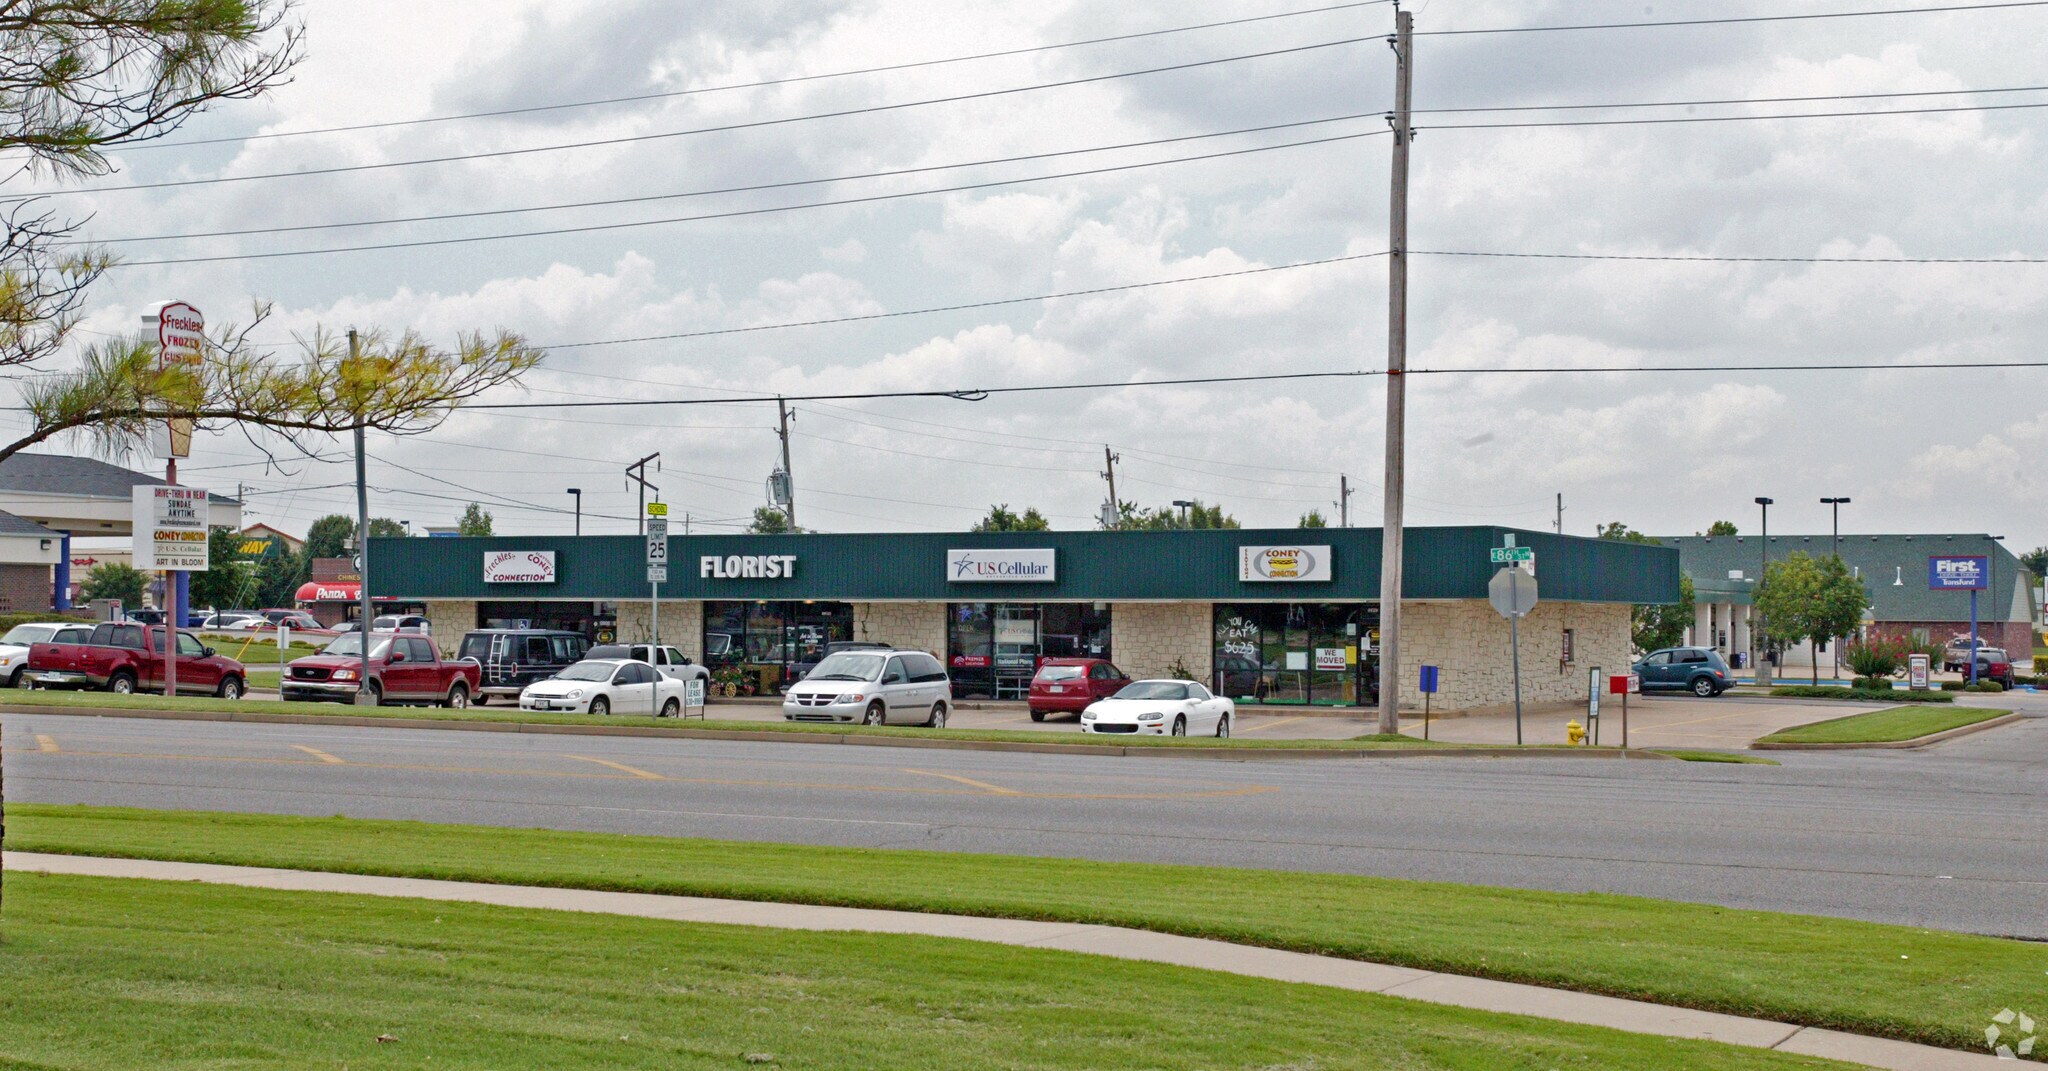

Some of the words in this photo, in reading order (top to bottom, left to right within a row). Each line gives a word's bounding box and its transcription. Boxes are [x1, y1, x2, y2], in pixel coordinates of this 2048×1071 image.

[168, 500, 192, 508] SUNDAE
[168, 509, 195, 518] ANYTIME
[649, 505, 666, 513] SCHOOL
[154, 531, 180, 541] CONEY
[649, 542, 665, 558] 25
[1266, 549, 1300, 557] CONEY
[156, 558, 169, 566] ART
[172, 558, 179, 566] IN
[181, 558, 204, 566] BLOOM
[527, 553, 554, 577] CONEY
[700, 555, 797, 579] FLORIST
[977, 561, 998, 575] U.S.
[998, 561, 1048, 575] Cellular
[493, 574, 546, 582] CONNECTION
[1228, 616, 1243, 626] YOU
[1229, 628, 1248, 638] EAT
[1316, 656, 1345, 664] MOVED
[690, 680, 699, 689] FOR
[688, 689, 701, 697] LEASE
